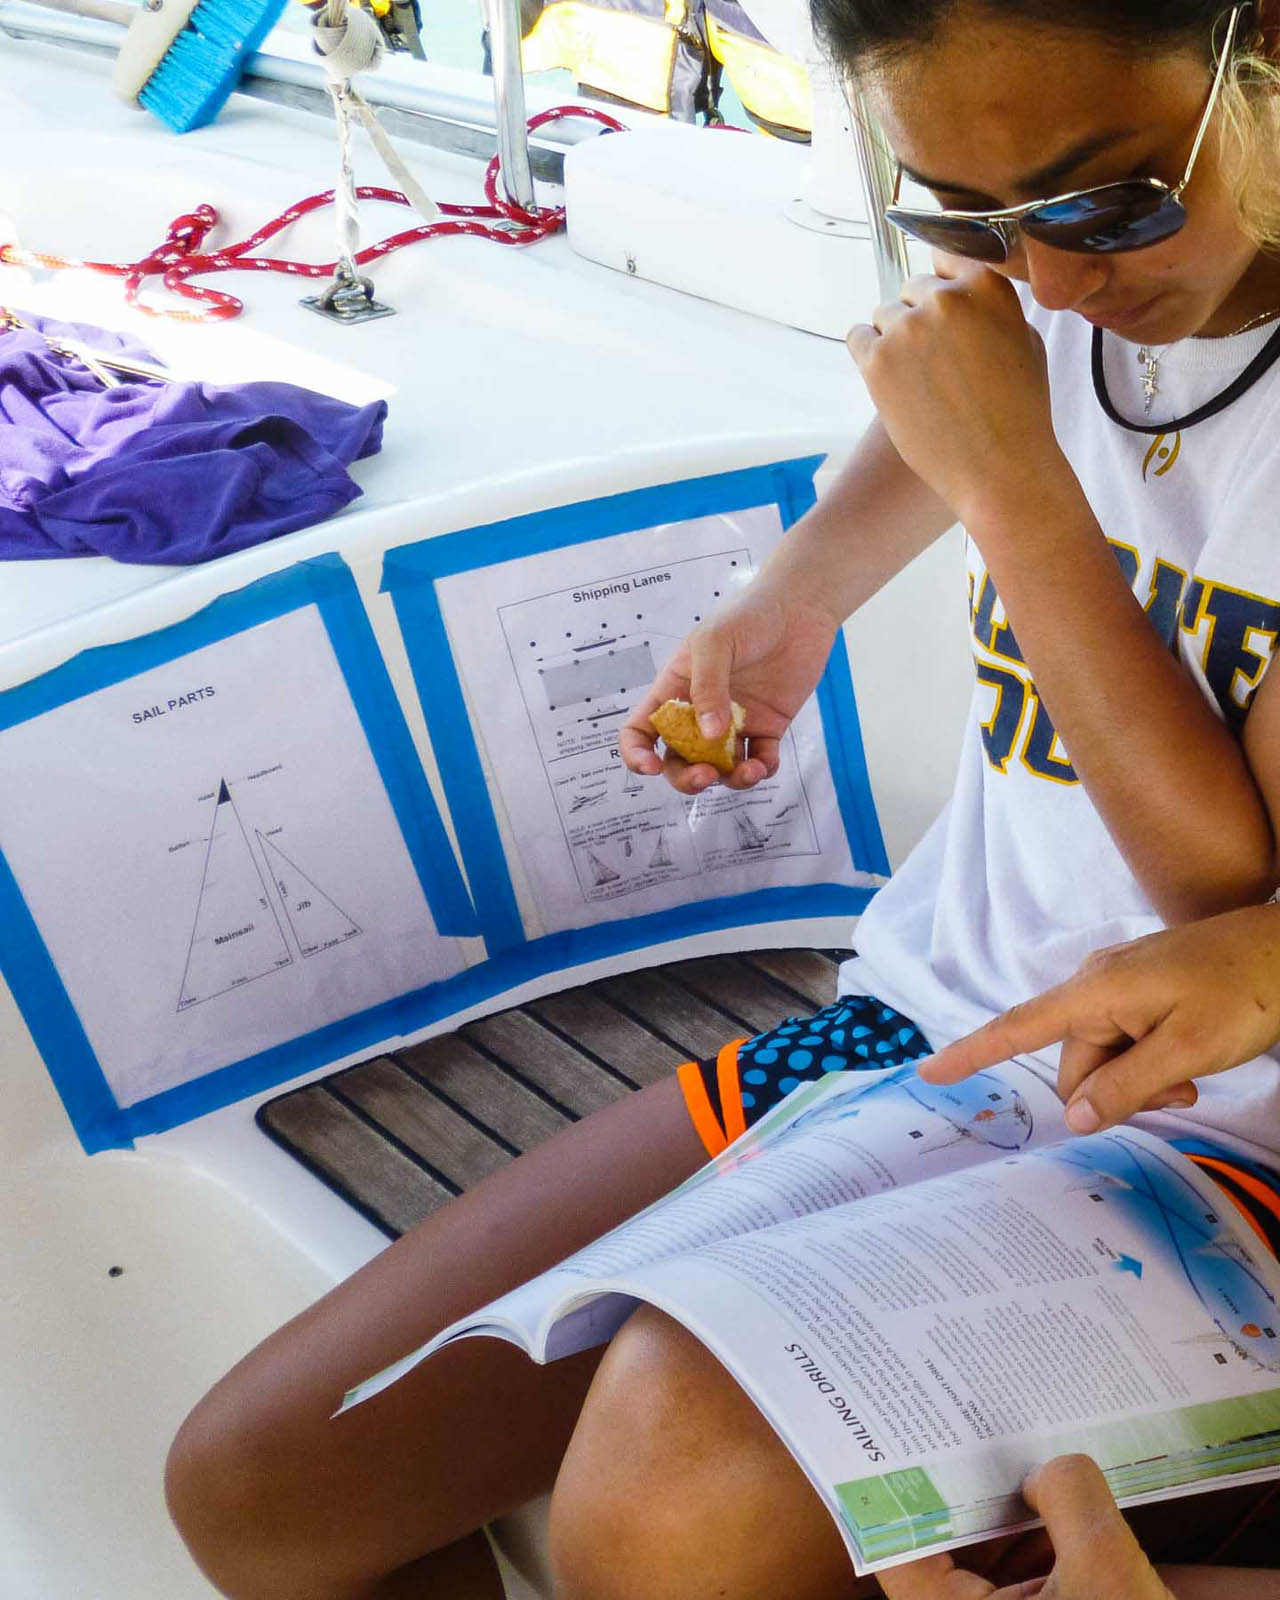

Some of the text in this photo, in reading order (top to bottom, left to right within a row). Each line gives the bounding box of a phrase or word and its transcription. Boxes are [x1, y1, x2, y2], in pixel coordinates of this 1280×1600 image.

[573, 572, 671, 603] Shipping Lanes
[132, 686, 216, 724] SAIL PARTS
[296, 900, 312, 912] Jib
[214, 923, 255, 946] Mainsail
[922, 1359, 944, 1381] DRILL
[784, 1343, 886, 1462] SAILING DRILLS
[966, 1400, 996, 1436] TACKING
